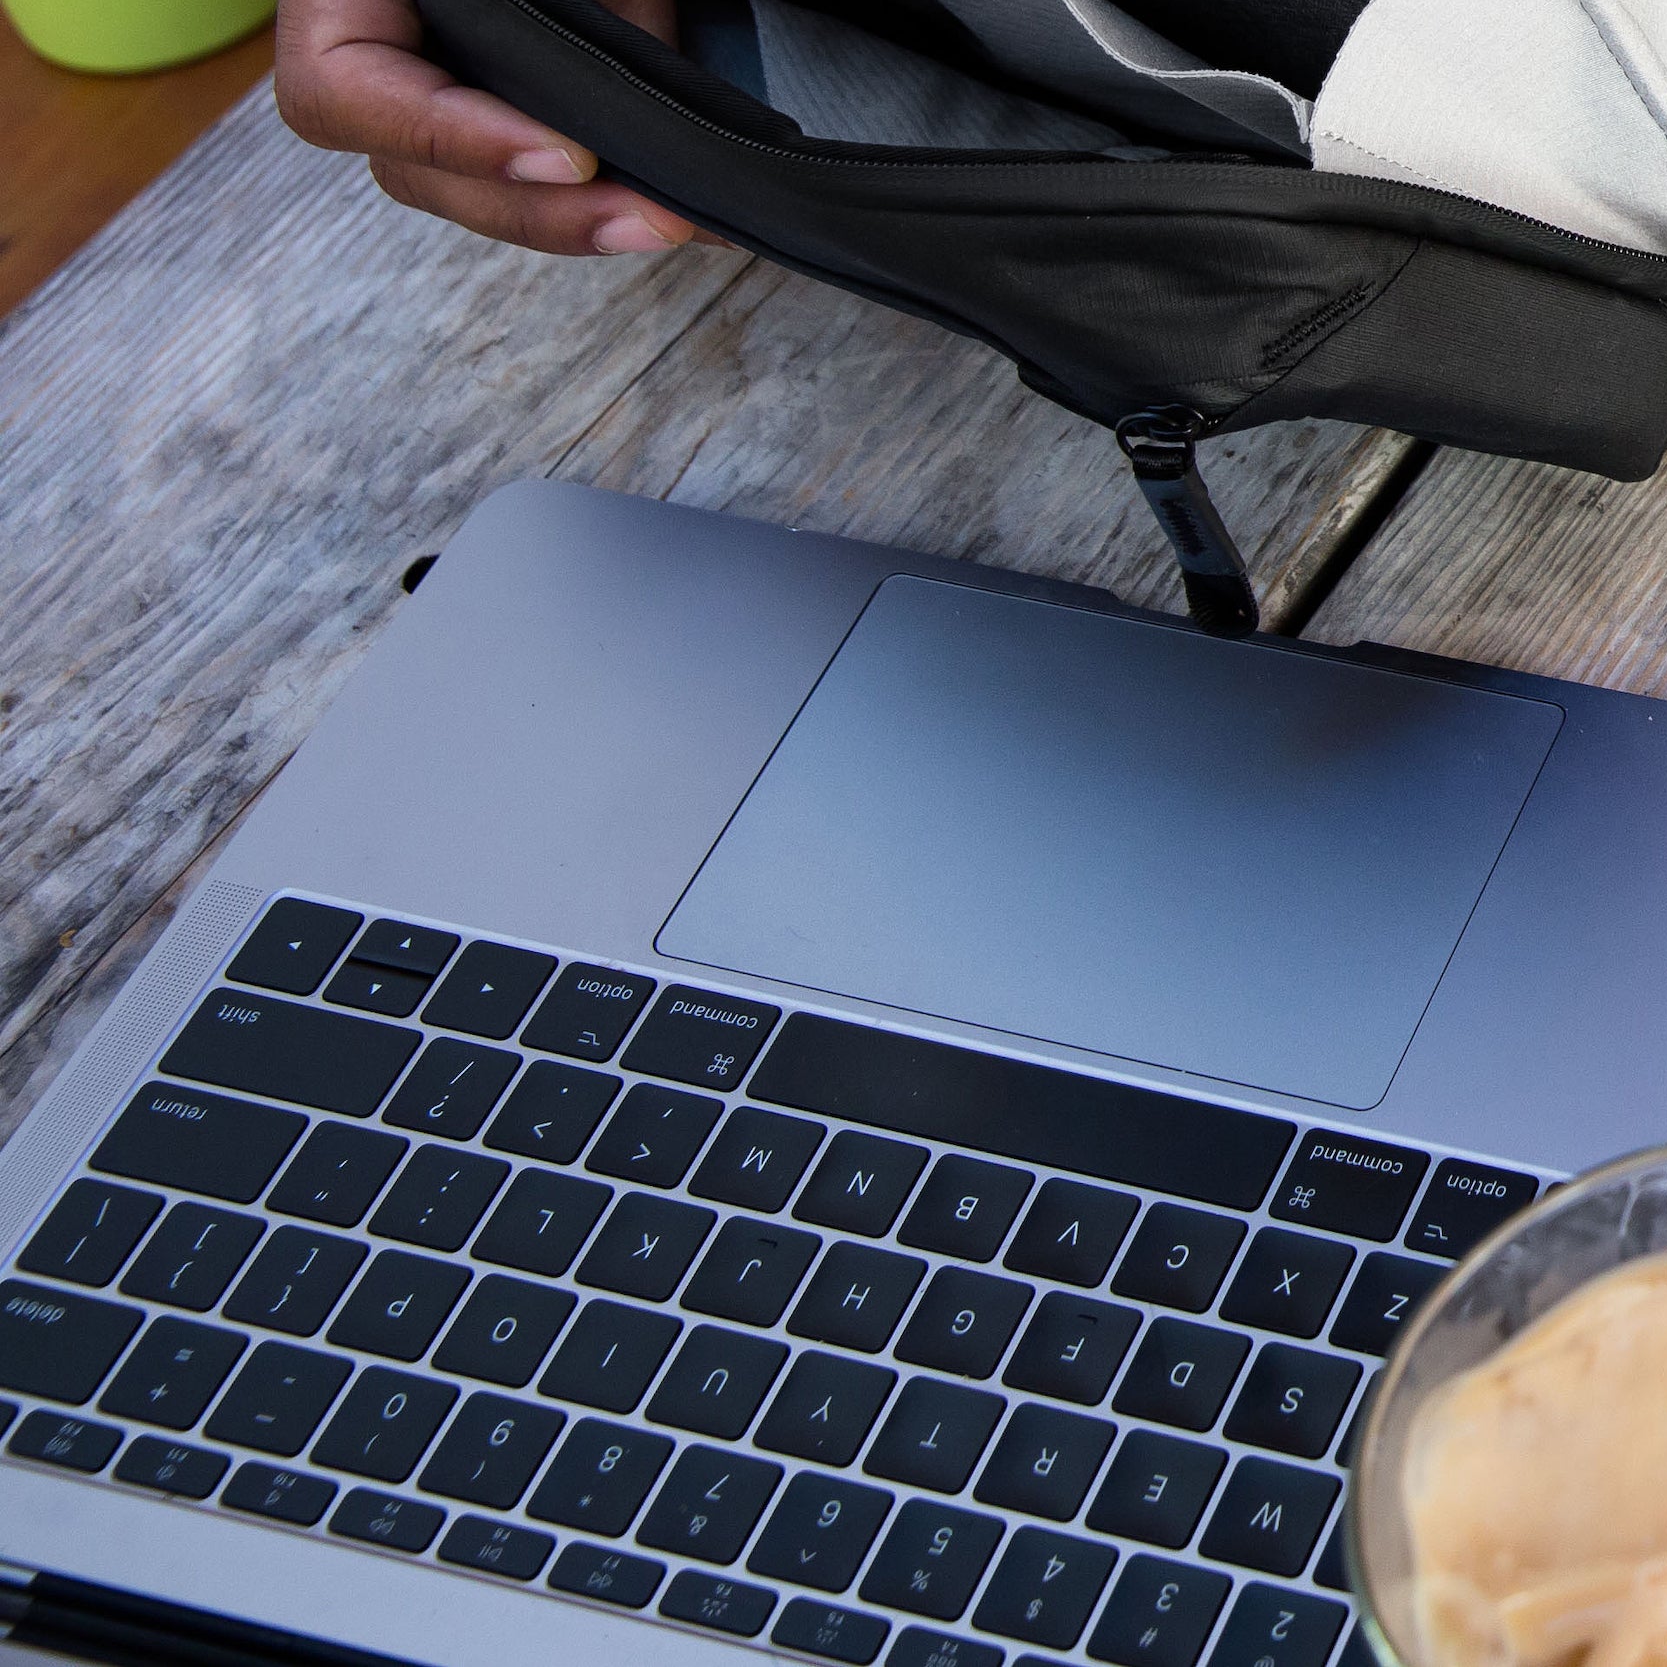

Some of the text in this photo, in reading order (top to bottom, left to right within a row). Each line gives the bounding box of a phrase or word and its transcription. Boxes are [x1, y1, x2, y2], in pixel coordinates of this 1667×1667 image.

[576, 978, 1507, 1198] option command command option
[150, 1098, 208, 1121] return
[217, 1004, 1409, 1321] Z X C V B N M < > ? shift
[538, 1209, 554, 1235] L
[631, 1233, 660, 1260] K
[738, 1259, 762, 1282] J
[386, 1293, 414, 1318] P
[842, 1283, 871, 1311] H
[4, 1297, 66, 1325] delete
[951, 1309, 976, 1336] G
[491, 1317, 517, 1343] O
[601, 1343, 618, 1368] I
[1060, 1337, 1085, 1362] F
[701, 1368, 729, 1396] U
[1169, 1361, 1195, 1388] D
[149, 1383, 167, 1402] +
[1279, 1387, 1304, 1414] S
[382, 1393, 407, 1420] 0
[810, 1395, 832, 1422] Y
[489, 1419, 514, 1446] 9
[919, 1422, 941, 1449] T
[598, 1445, 623, 1473] 8
[1032, 1447, 1059, 1477] R
[704, 1474, 730, 1500] 7
[1143, 1474, 1169, 1503] E
[688, 1514, 708, 1536] &
[816, 1500, 841, 1528] 6
[1250, 1502, 1282, 1533] W
[928, 1527, 953, 1556] 5
[910, 1569, 932, 1592] %
[1042, 1555, 1066, 1583] 4
[1025, 1598, 1043, 1621] $
[1155, 1583, 1180, 1612] 3
[1139, 1627, 1158, 1648] #
[1270, 1610, 1295, 1641] 2
